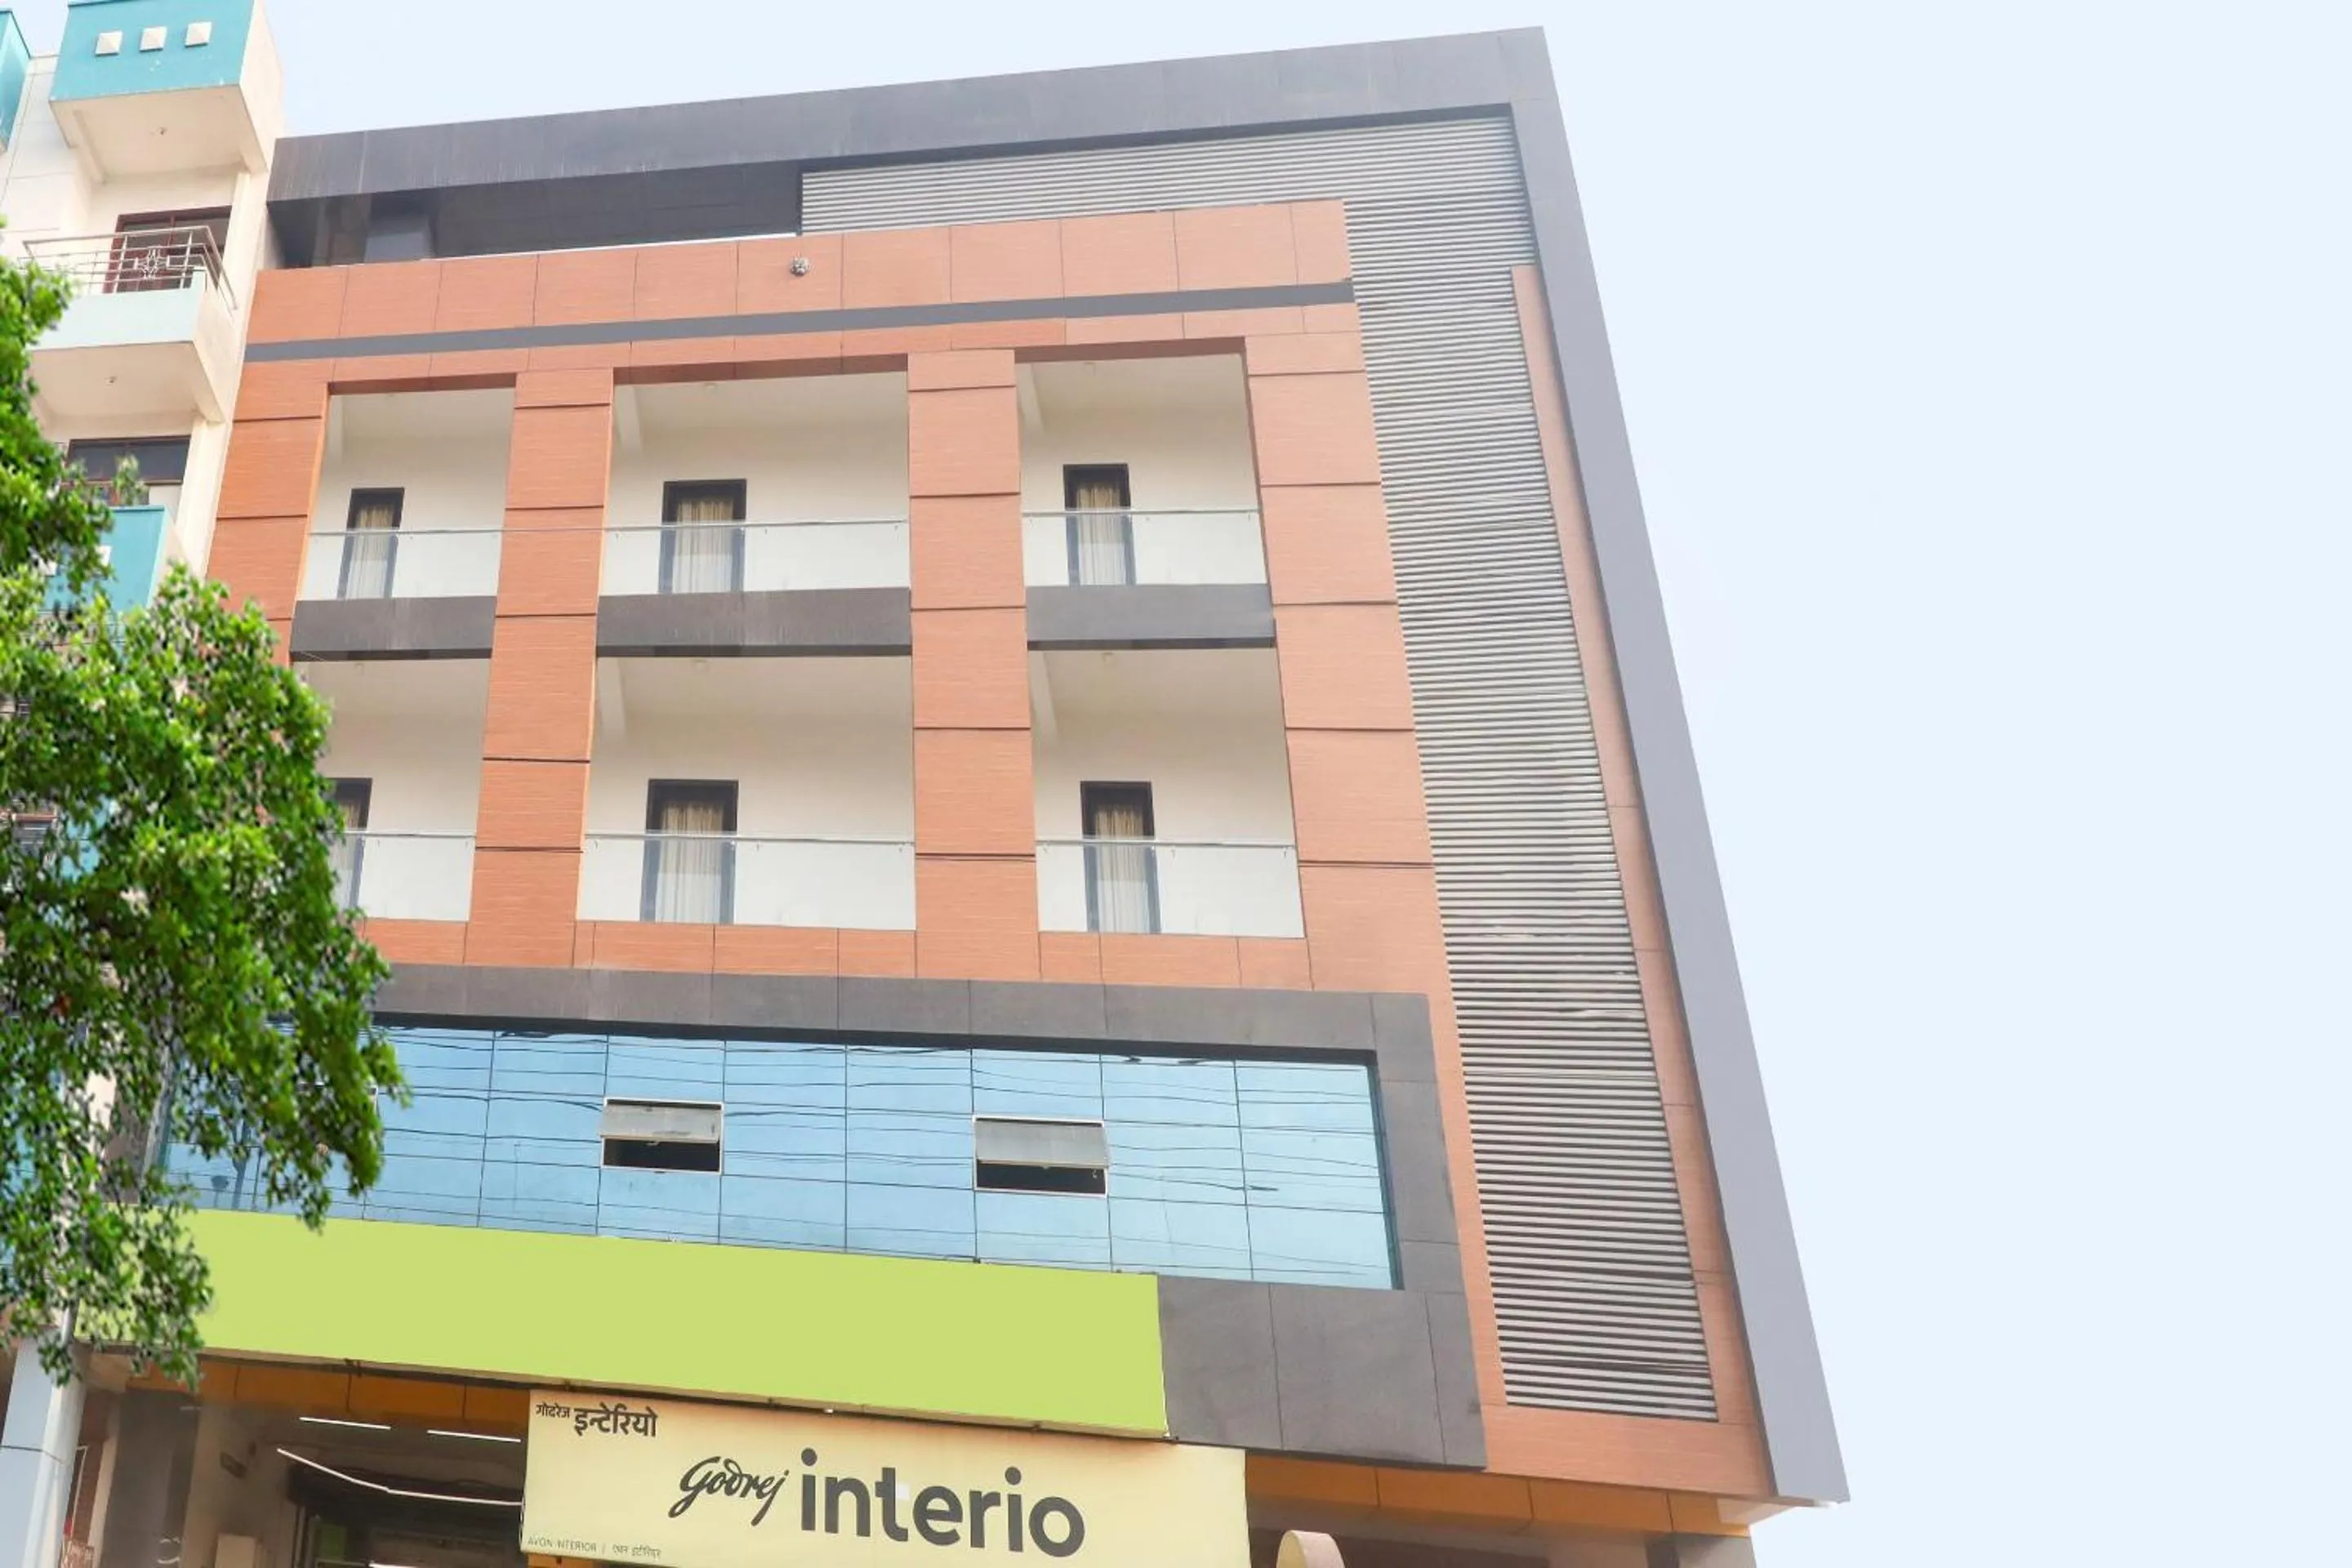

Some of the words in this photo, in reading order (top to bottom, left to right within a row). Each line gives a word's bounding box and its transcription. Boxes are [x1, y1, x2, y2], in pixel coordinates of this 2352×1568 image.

[536, 1401, 570, 1419] गोदरेज
[574, 1401, 657, 1437] इन्टेरियो
[668, 1456, 790, 1526] Godrej
[800, 1447, 1085, 1557] interio
[528, 1536, 553, 1548] AVON
[557, 1539, 597, 1552] NTERIOR
